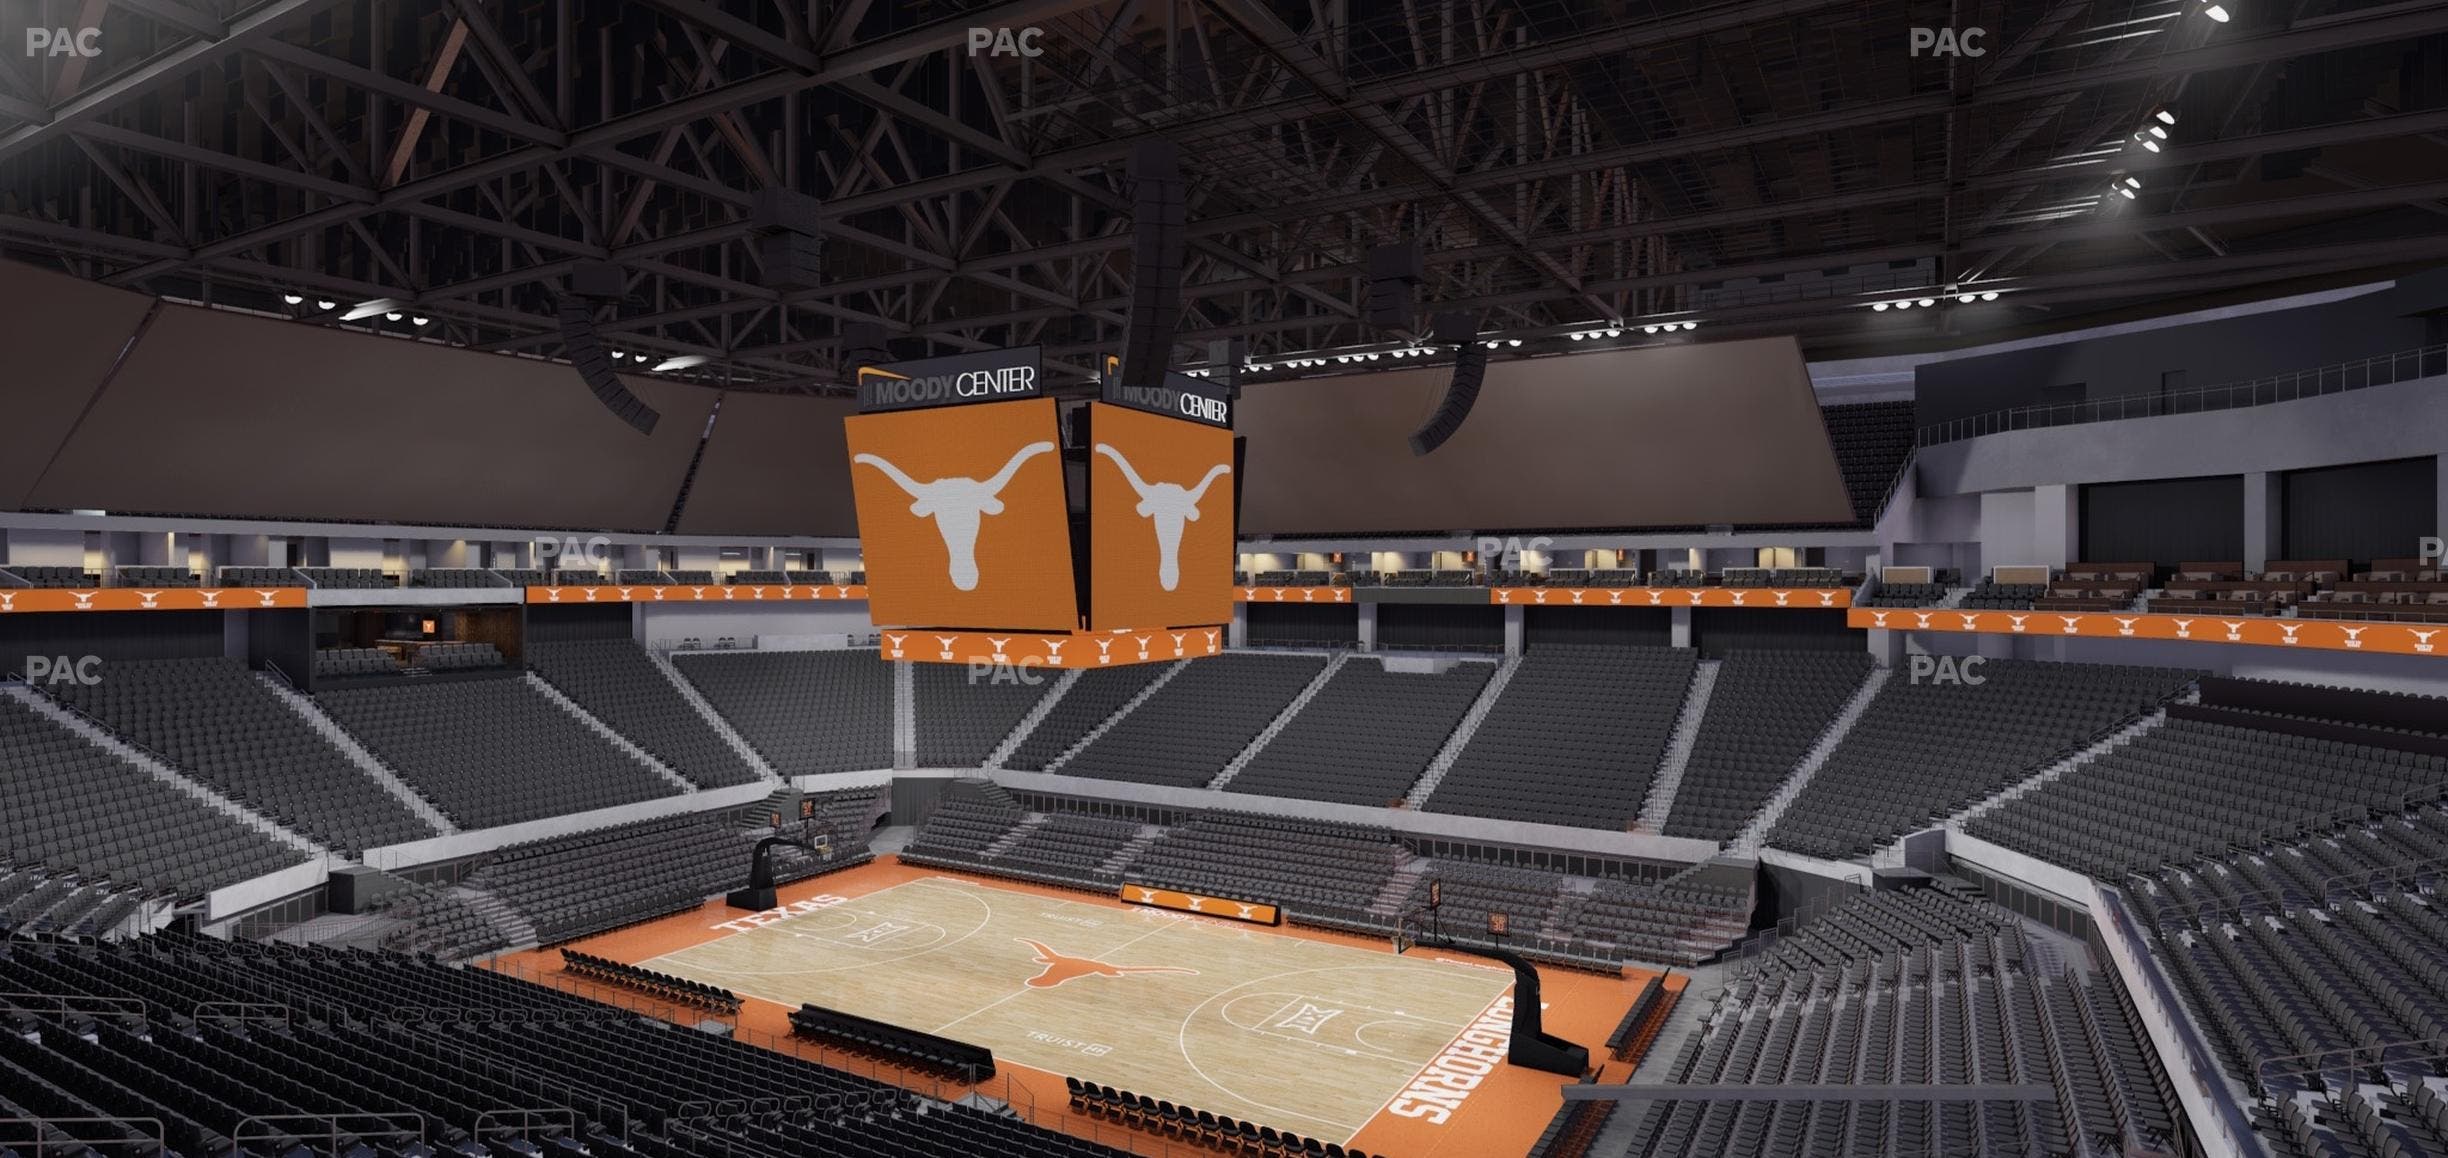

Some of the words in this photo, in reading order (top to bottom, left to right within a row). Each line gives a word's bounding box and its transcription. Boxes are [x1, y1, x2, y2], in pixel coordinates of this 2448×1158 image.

[876, 374, 955, 404] MOODY
[956, 366, 1035, 397] CENTER
[1123, 386, 1180, 411] MOODY
[1180, 393, 1227, 423] CENTER
[709, 894, 848, 934] TEXAS
[1026, 1031, 1087, 1049] TRUIST
[1388, 996, 1549, 1125] ONGHORNS
